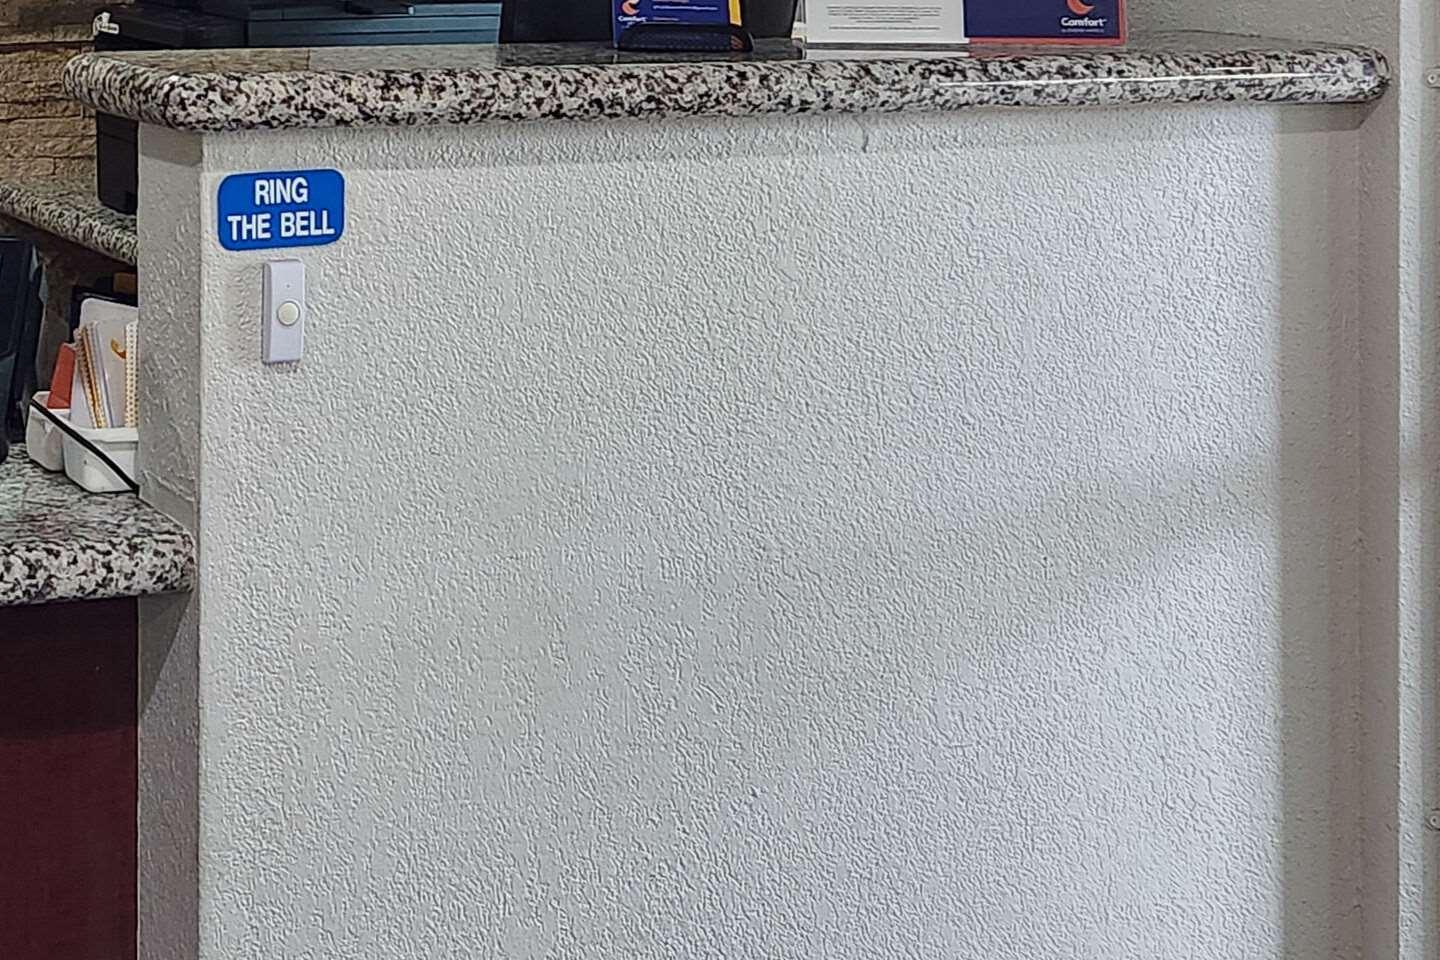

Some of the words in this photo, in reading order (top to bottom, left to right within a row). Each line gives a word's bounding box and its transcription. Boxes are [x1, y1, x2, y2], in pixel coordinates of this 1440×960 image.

[1060, 17, 1105, 27] Comfort
[254, 176, 309, 206] RING
[227, 212, 271, 241] THE
[280, 210, 335, 238] BELL
